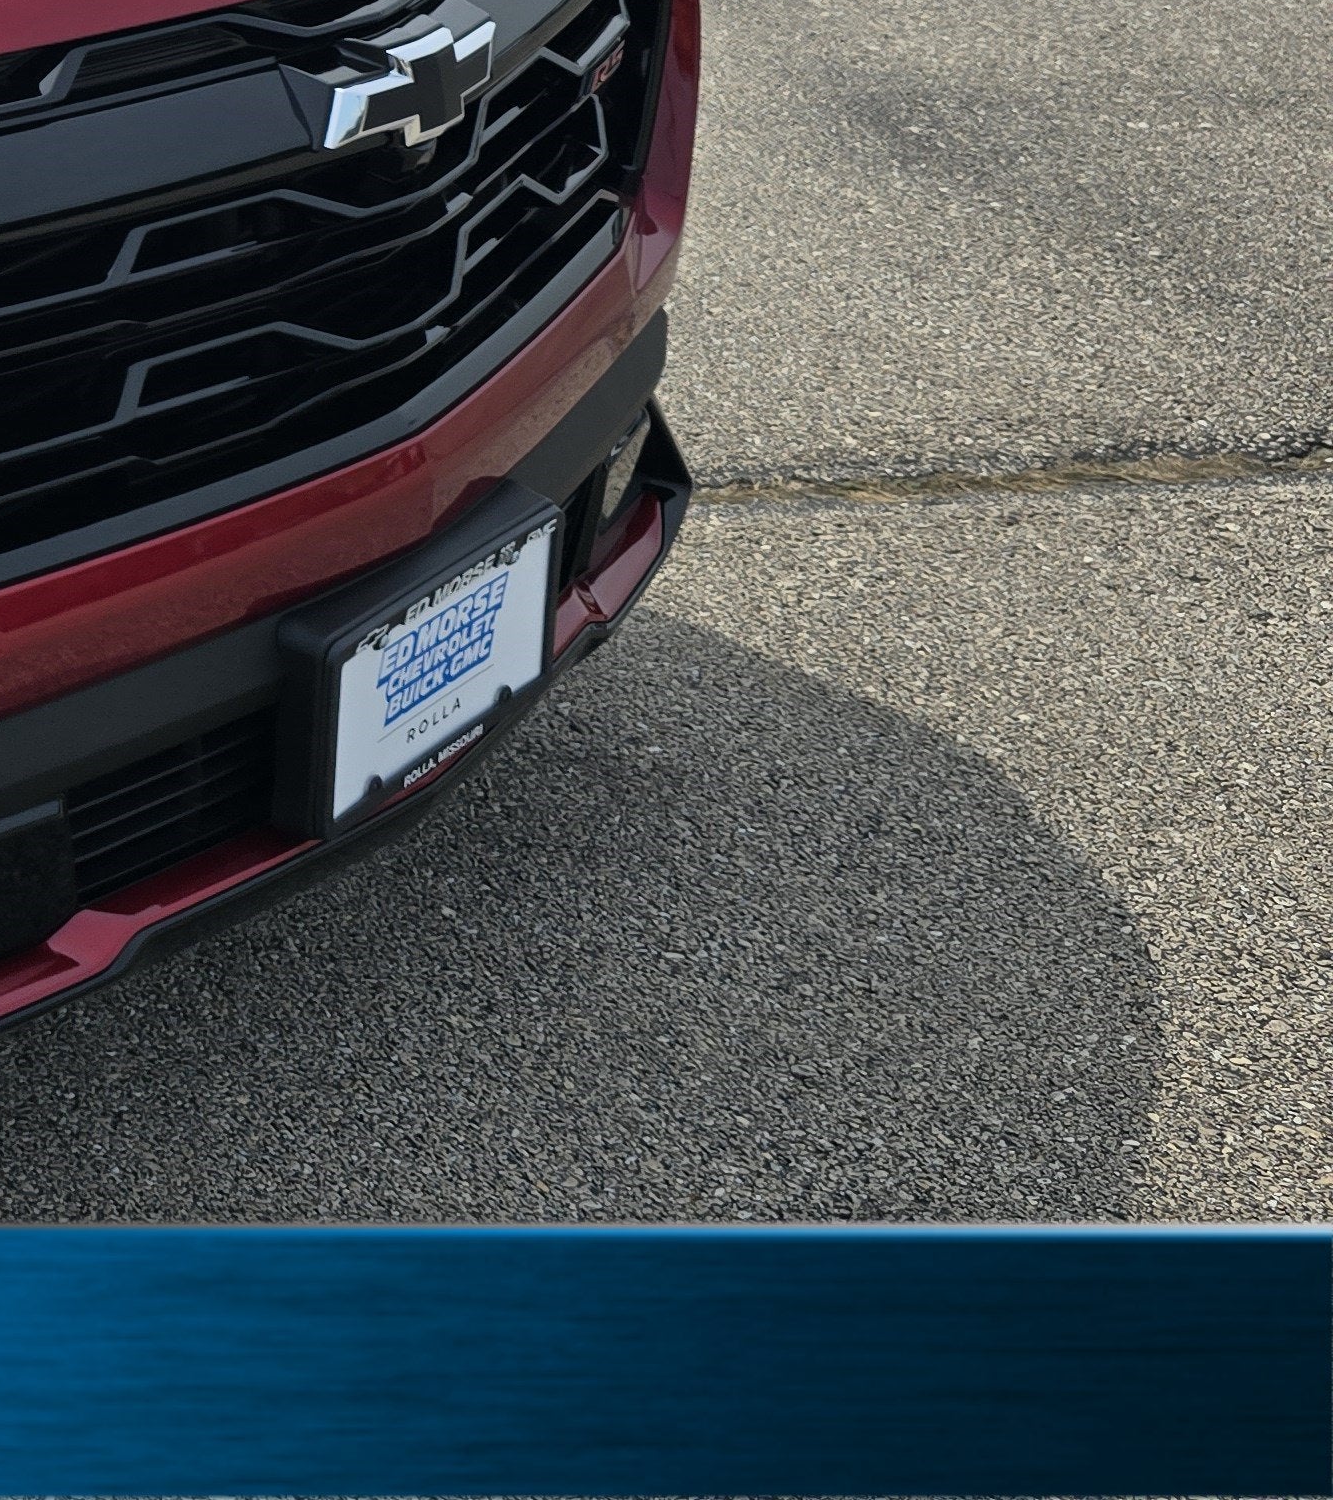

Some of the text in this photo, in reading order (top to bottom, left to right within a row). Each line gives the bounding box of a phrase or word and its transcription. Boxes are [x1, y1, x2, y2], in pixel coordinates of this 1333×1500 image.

[381, 576, 508, 676] ED MORSE
[387, 611, 496, 699] CHEVROLET
[406, 697, 462, 744] ROLLA
